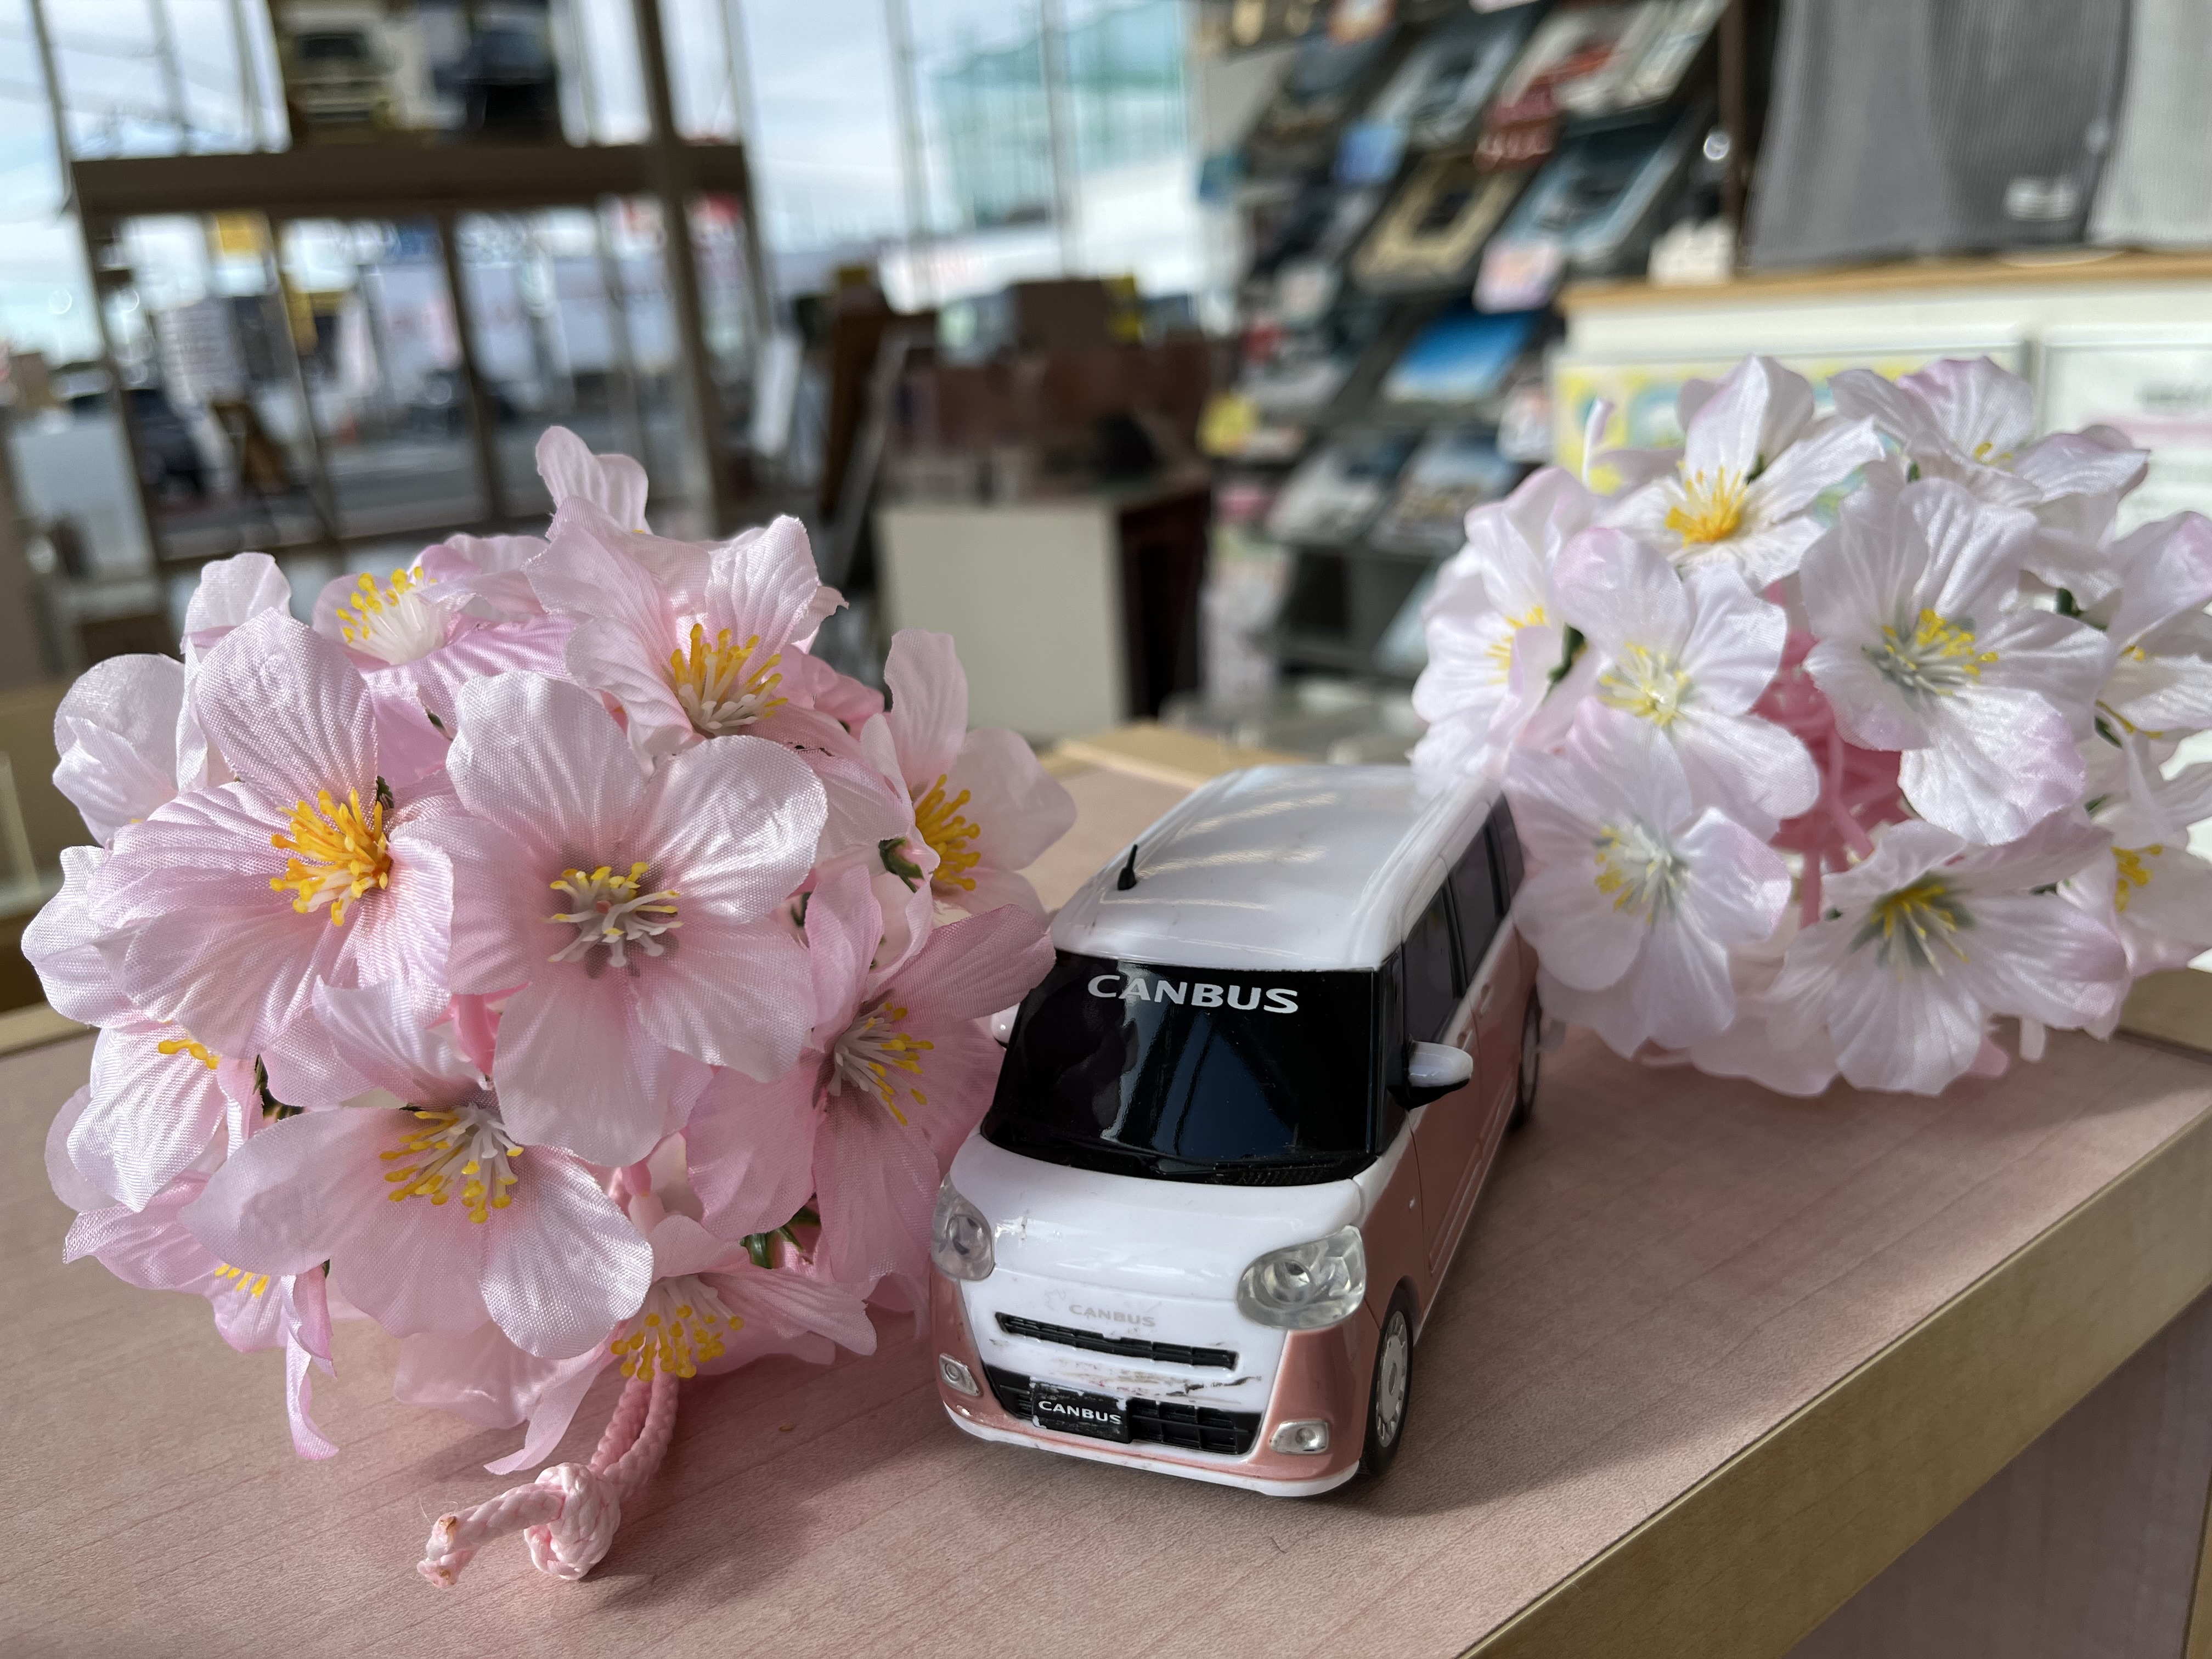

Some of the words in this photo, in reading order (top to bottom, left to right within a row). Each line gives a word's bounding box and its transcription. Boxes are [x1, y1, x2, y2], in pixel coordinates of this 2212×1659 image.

[1087, 974, 1299, 1014] CANBUS
[1069, 1304, 1156, 1327] CANBUS
[1038, 1401, 1122, 1425] CANBUS
